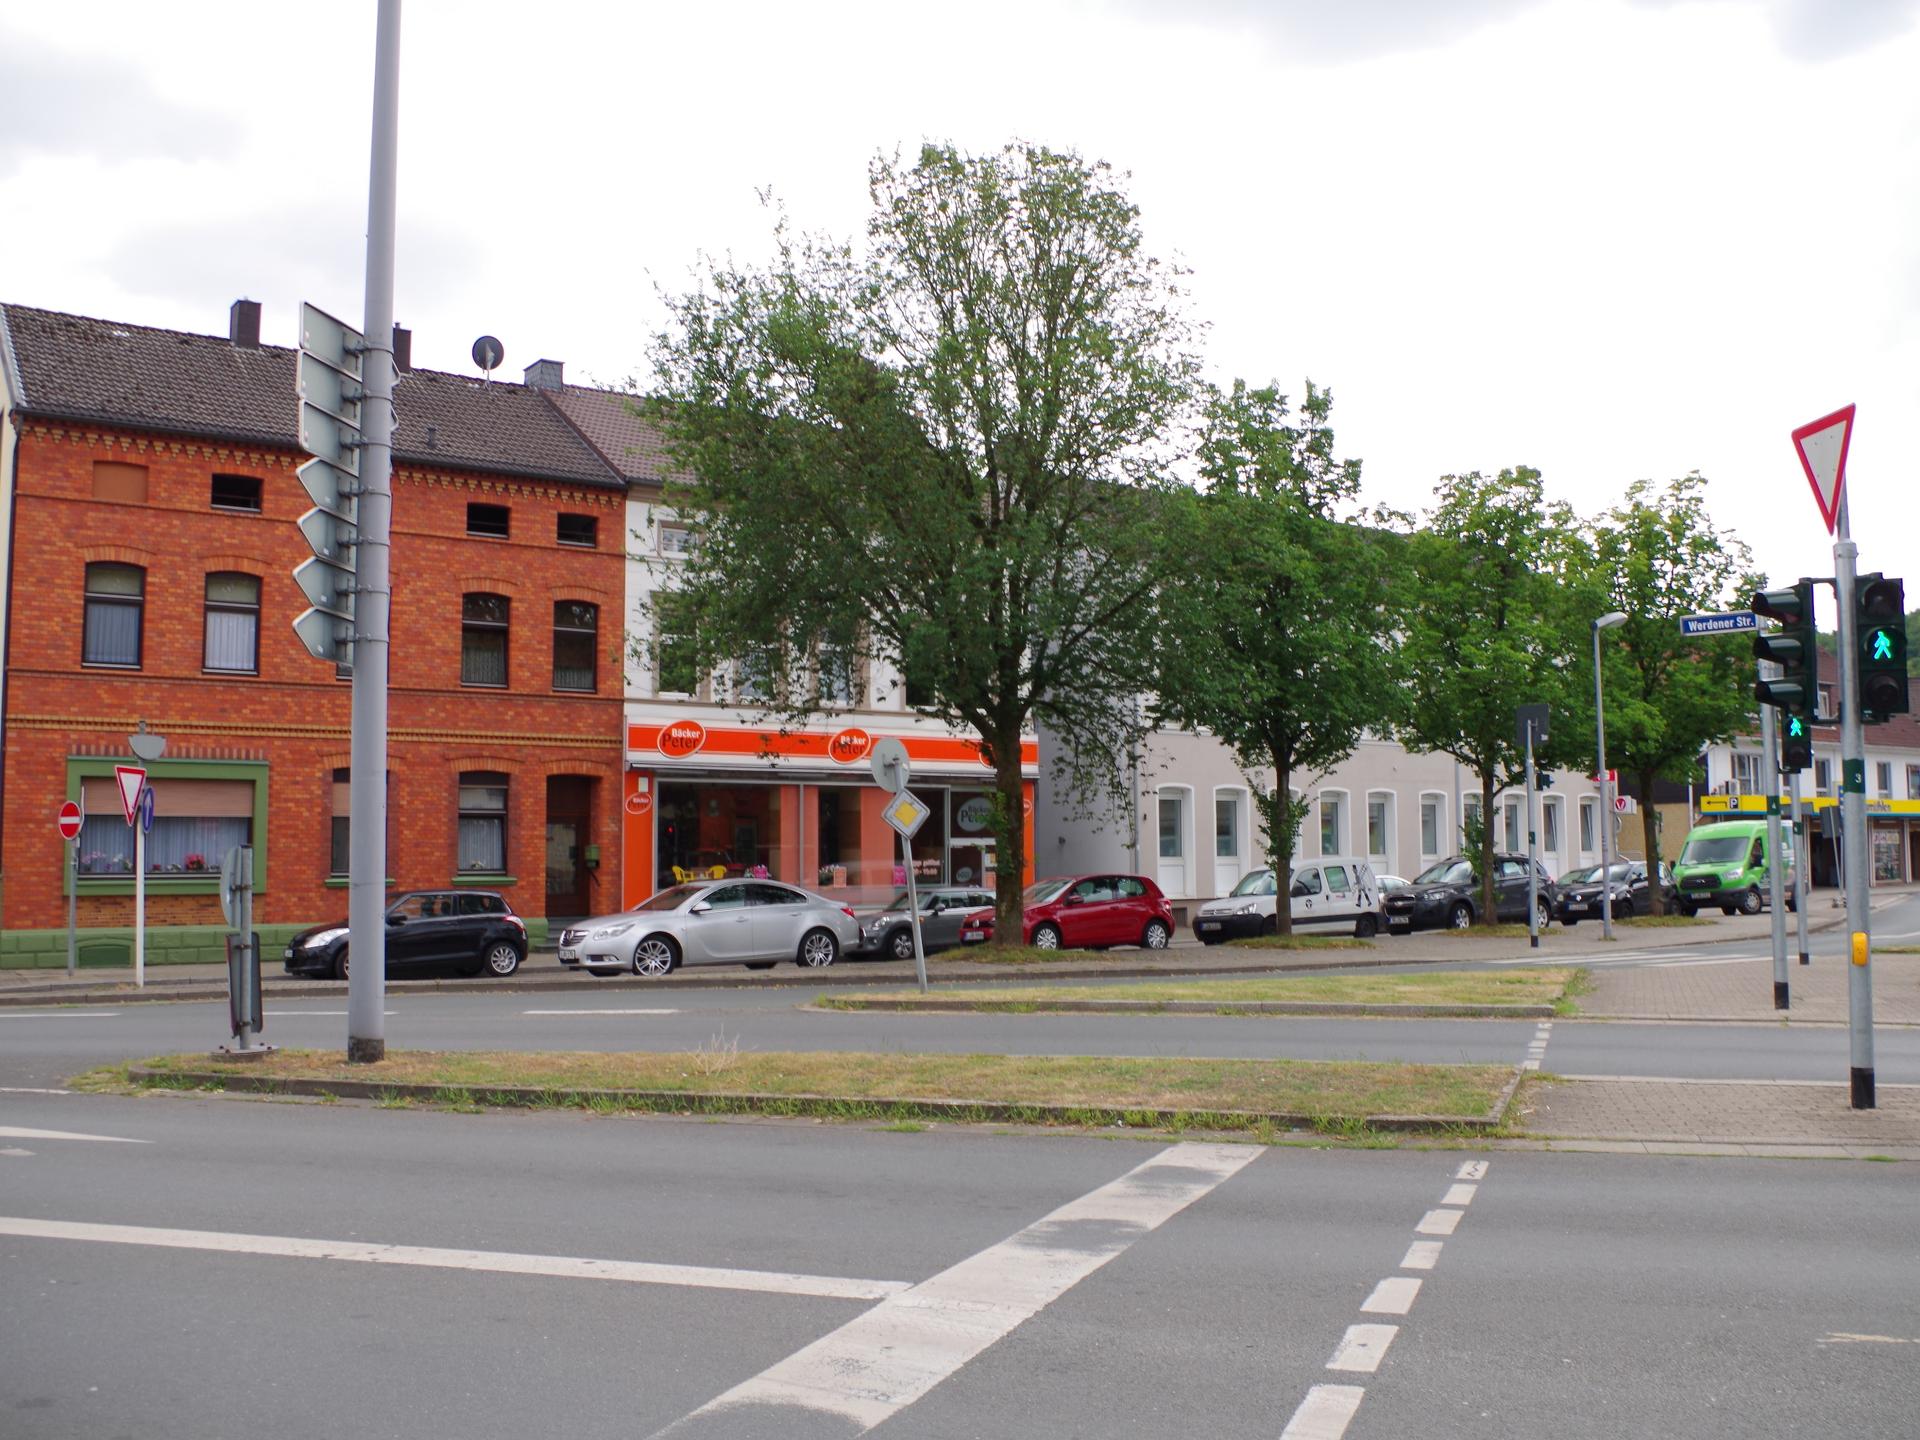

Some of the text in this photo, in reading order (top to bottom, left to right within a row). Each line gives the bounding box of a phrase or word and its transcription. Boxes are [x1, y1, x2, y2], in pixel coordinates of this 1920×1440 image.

[1688, 616, 1754, 632] Werdener Str.
[671, 728, 701, 739] Bäcker
[661, 732, 698, 750] Peter
[1855, 773, 1862, 784] 3
[1729, 797, 1739, 809] P
